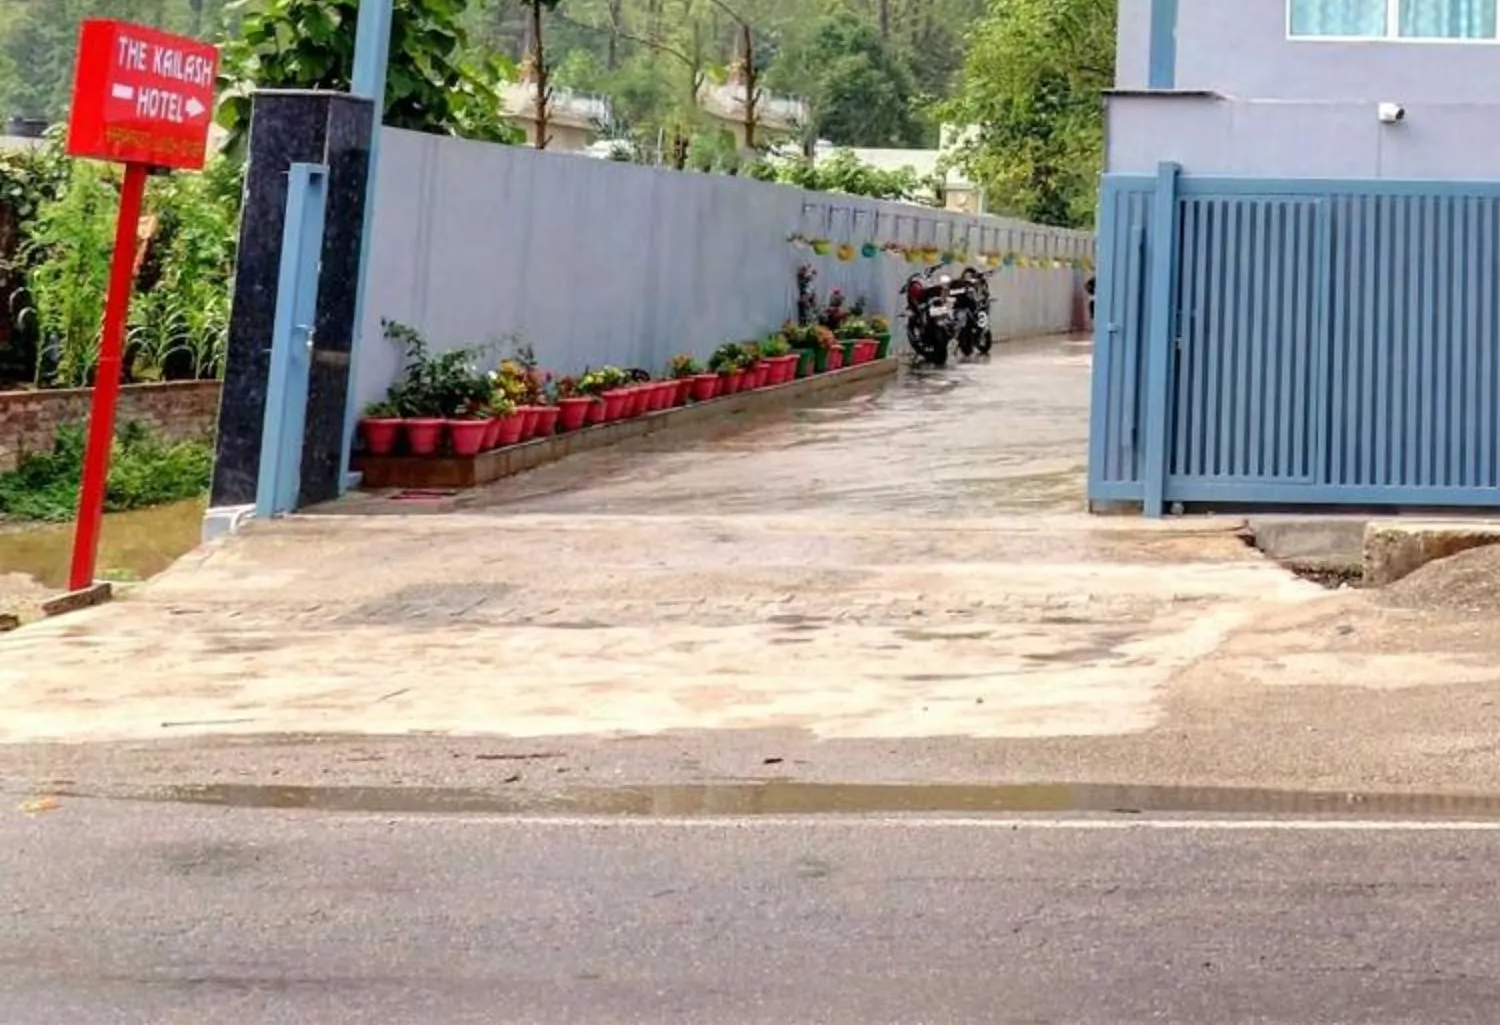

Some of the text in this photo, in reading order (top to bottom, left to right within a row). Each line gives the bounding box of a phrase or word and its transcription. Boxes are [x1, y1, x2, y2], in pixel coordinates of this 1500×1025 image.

[118, 36, 213, 86] THE KAILASH
[136, 87, 183, 124] HOTEL
